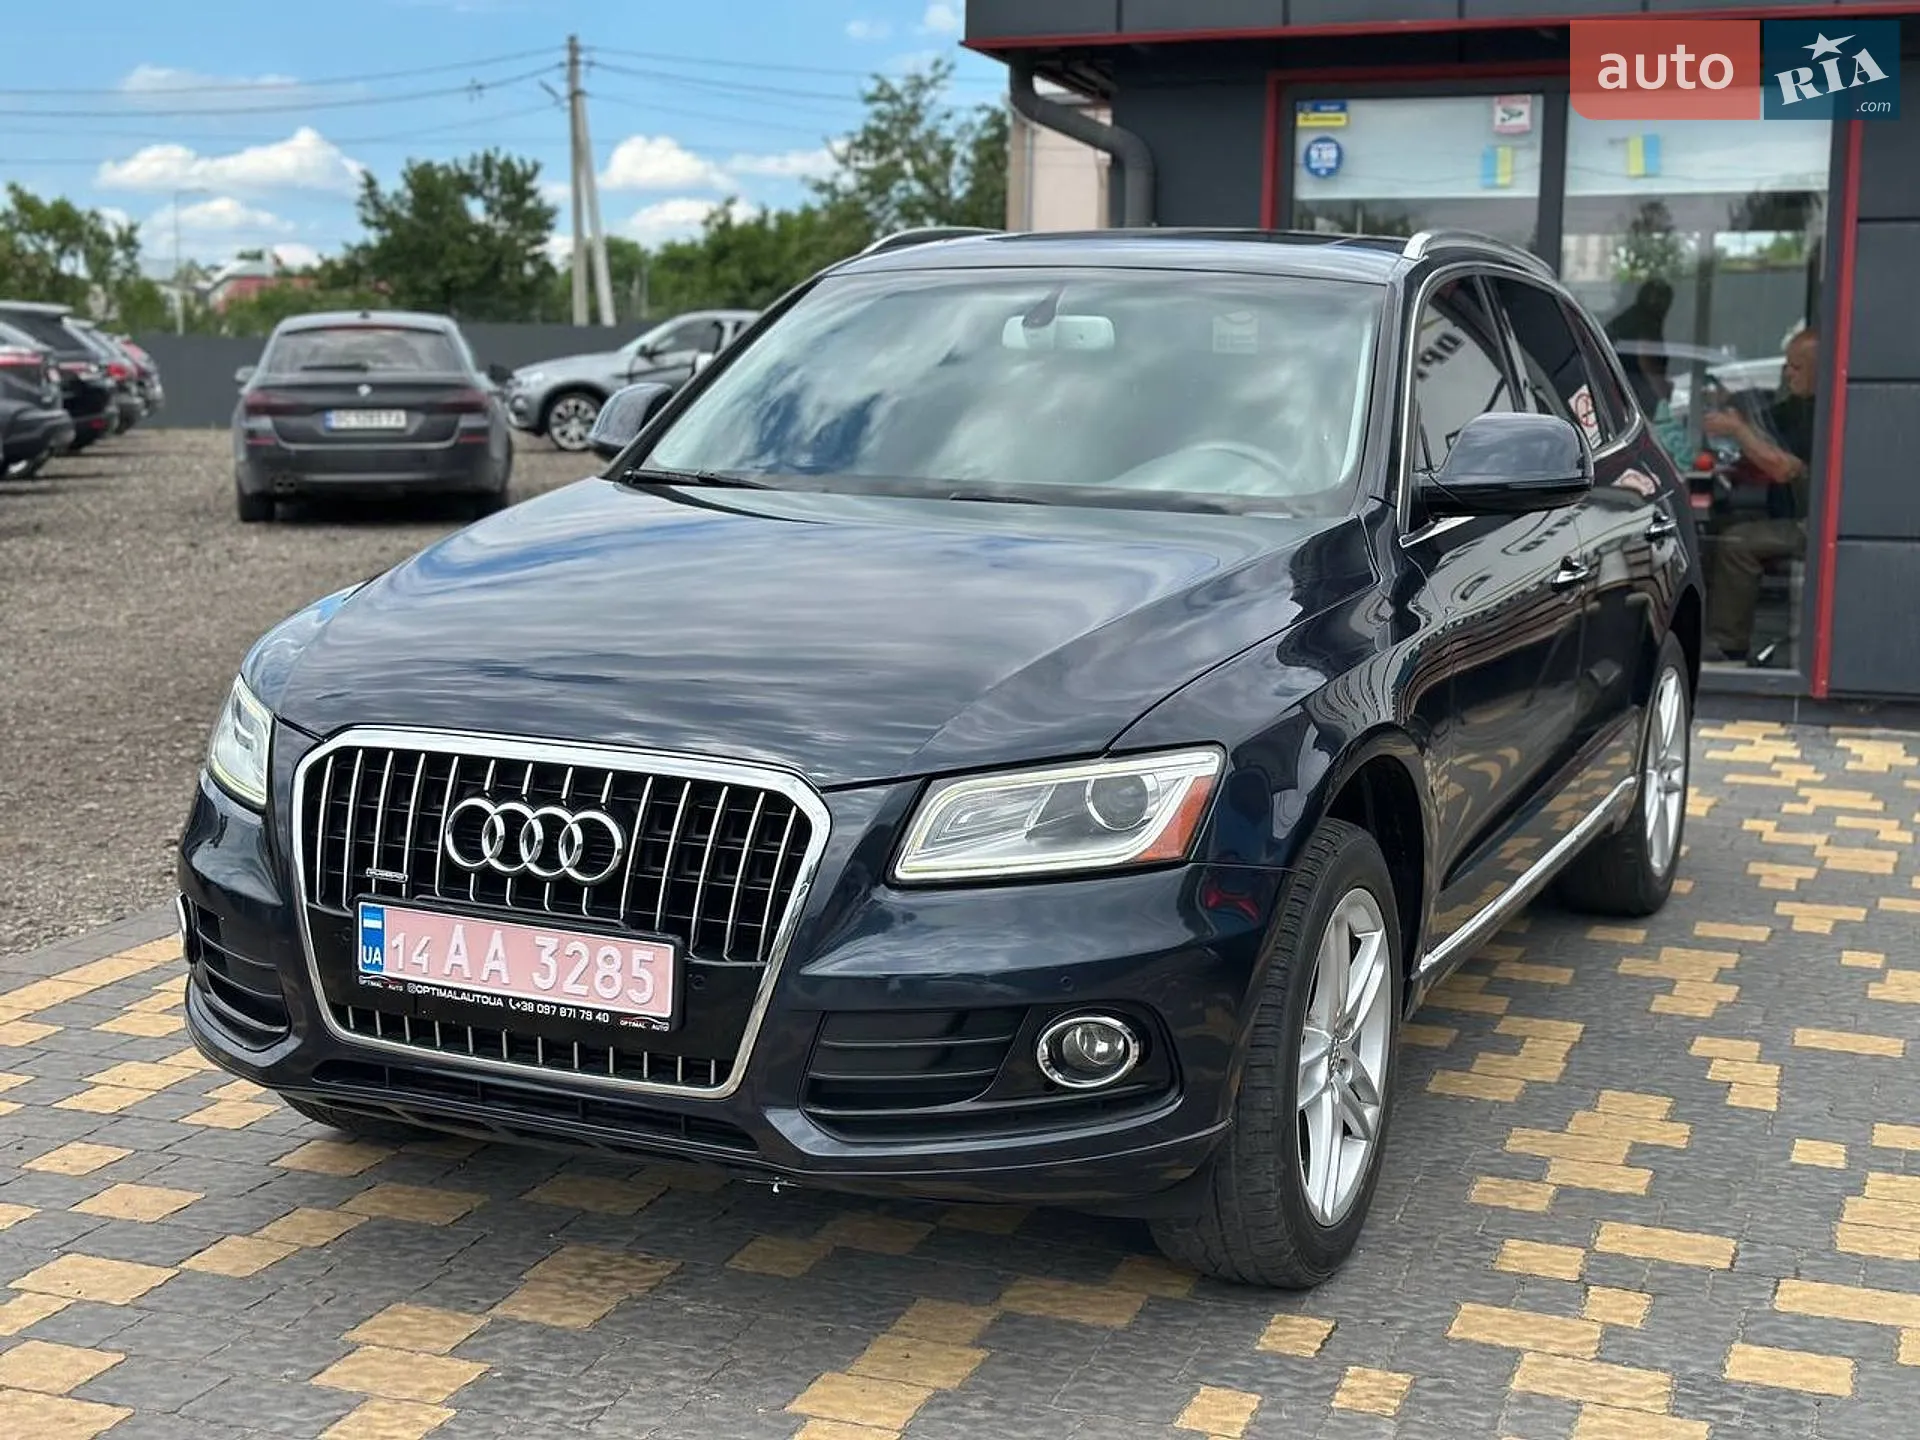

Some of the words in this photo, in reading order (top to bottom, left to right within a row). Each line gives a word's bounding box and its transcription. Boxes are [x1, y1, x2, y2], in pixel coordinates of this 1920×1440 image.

[362, 944, 384, 965] UA
[531, 936, 655, 1005] 3285
[595, 1012, 609, 1023] 40
